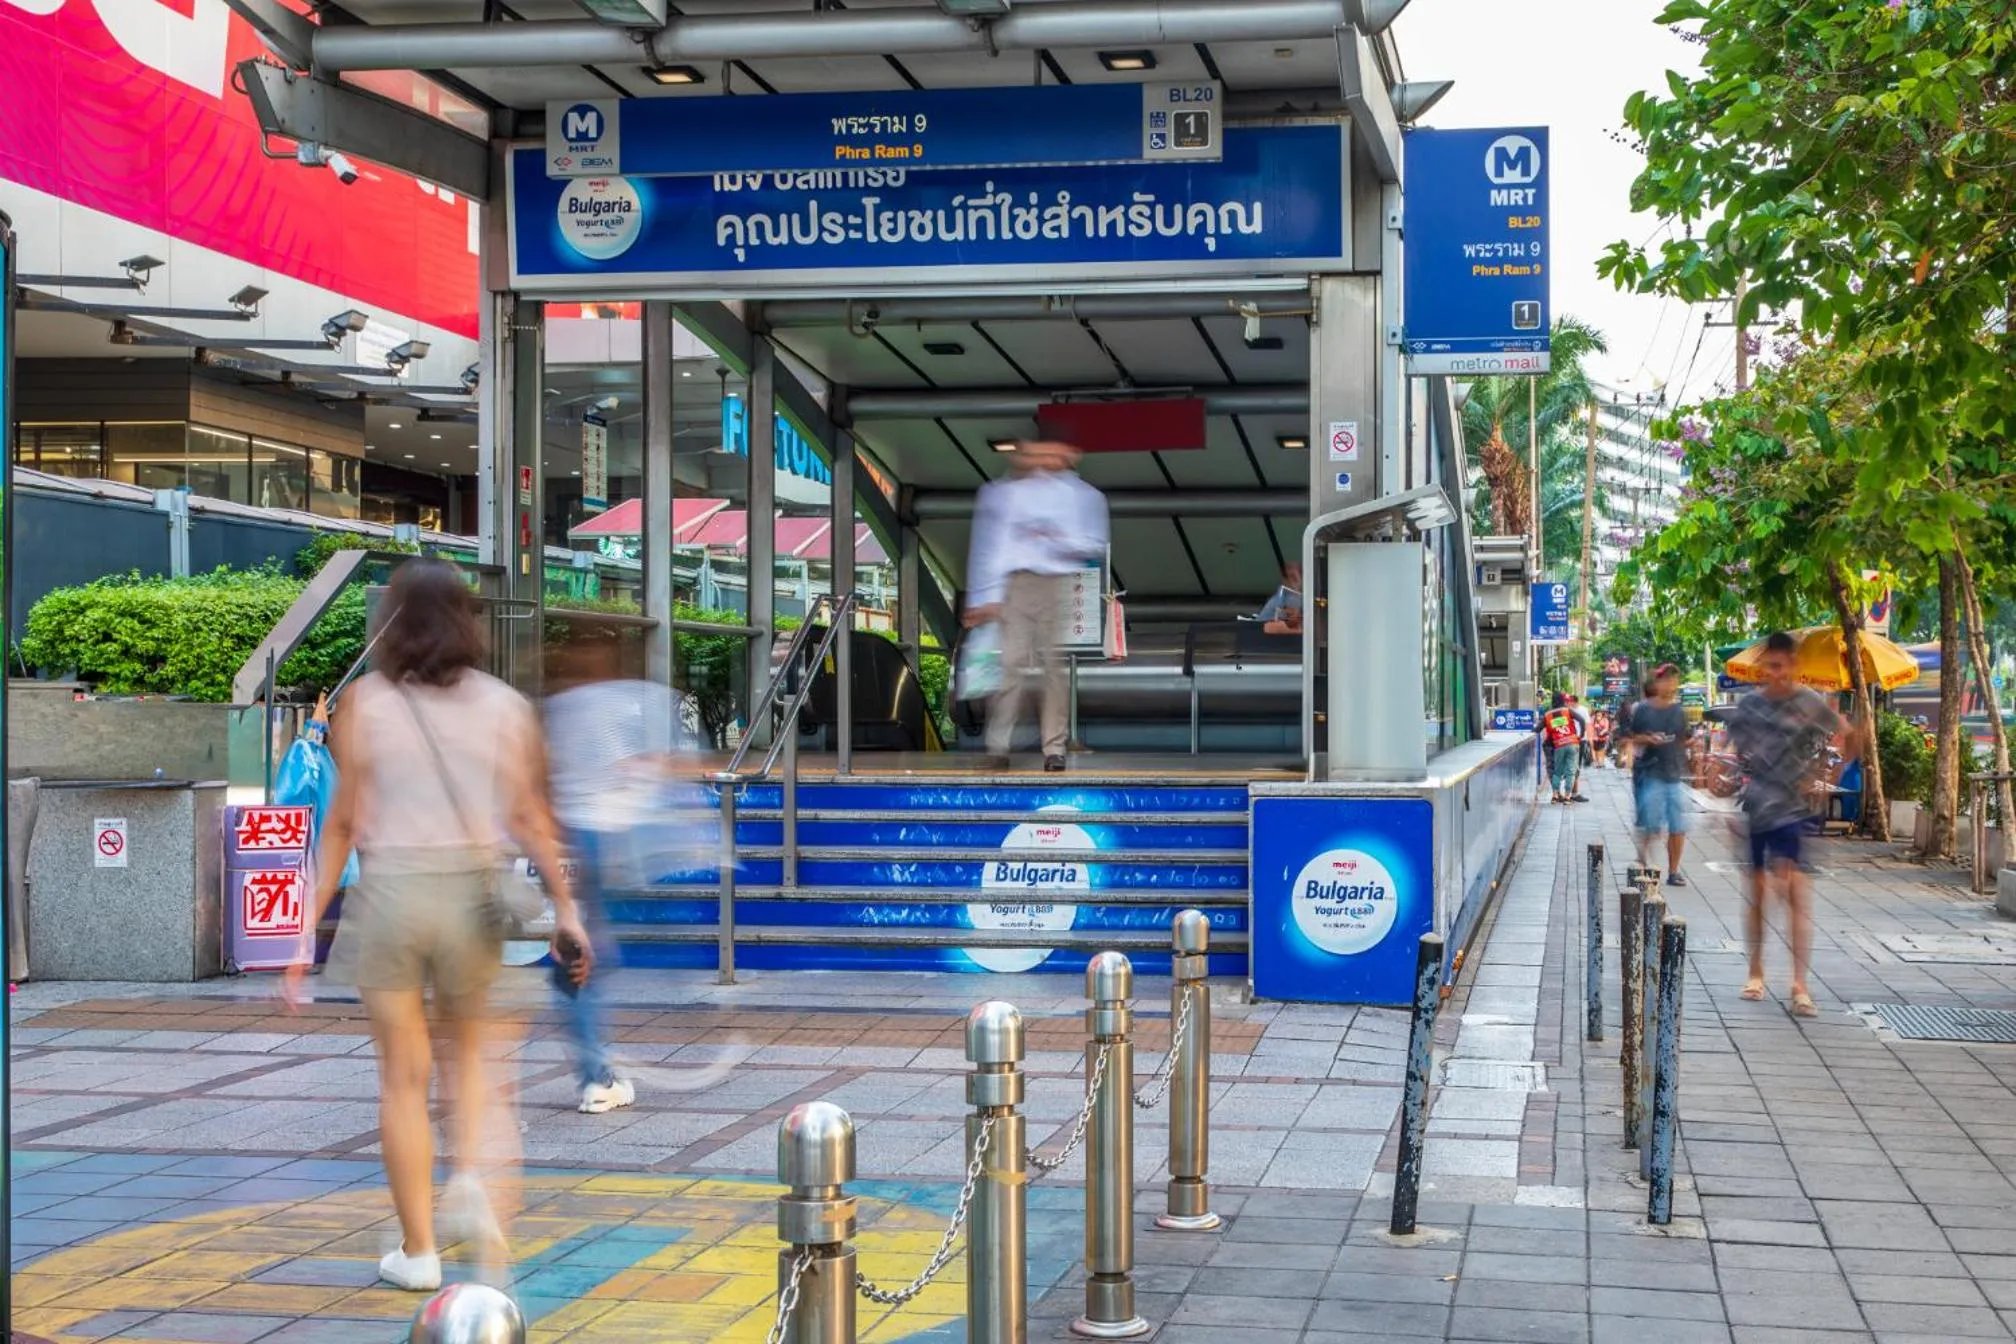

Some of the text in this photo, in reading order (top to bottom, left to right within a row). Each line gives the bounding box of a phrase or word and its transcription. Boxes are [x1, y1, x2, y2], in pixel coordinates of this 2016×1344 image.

[1170, 87, 1214, 103] BL20
[831, 113, 928, 135] พระราม 9
[1185, 114, 1196, 135] 1
[568, 144, 597, 153] MRT
[834, 143, 924, 160] Phra Ram 9
[1489, 188, 1537, 206] MRT
[568, 196, 632, 217] Bulgaria
[576, 219, 604, 230] Yogurt
[1507, 216, 1541, 229] BL20
[1463, 241, 1541, 259] พระราม 9
[1472, 263, 1542, 276] Phra Ram 9
[1520, 303, 1530, 321] 1
[1450, 355, 1541, 371] metro mall
[1036, 827, 1062, 839] meiji
[1332, 860, 1358, 871] meiji
[995, 861, 1077, 888] Bulgaria
[1304, 879, 1386, 905] Bulgaria
[990, 903, 1027, 917] Yogurt
[1314, 905, 1350, 918] Yogurt
